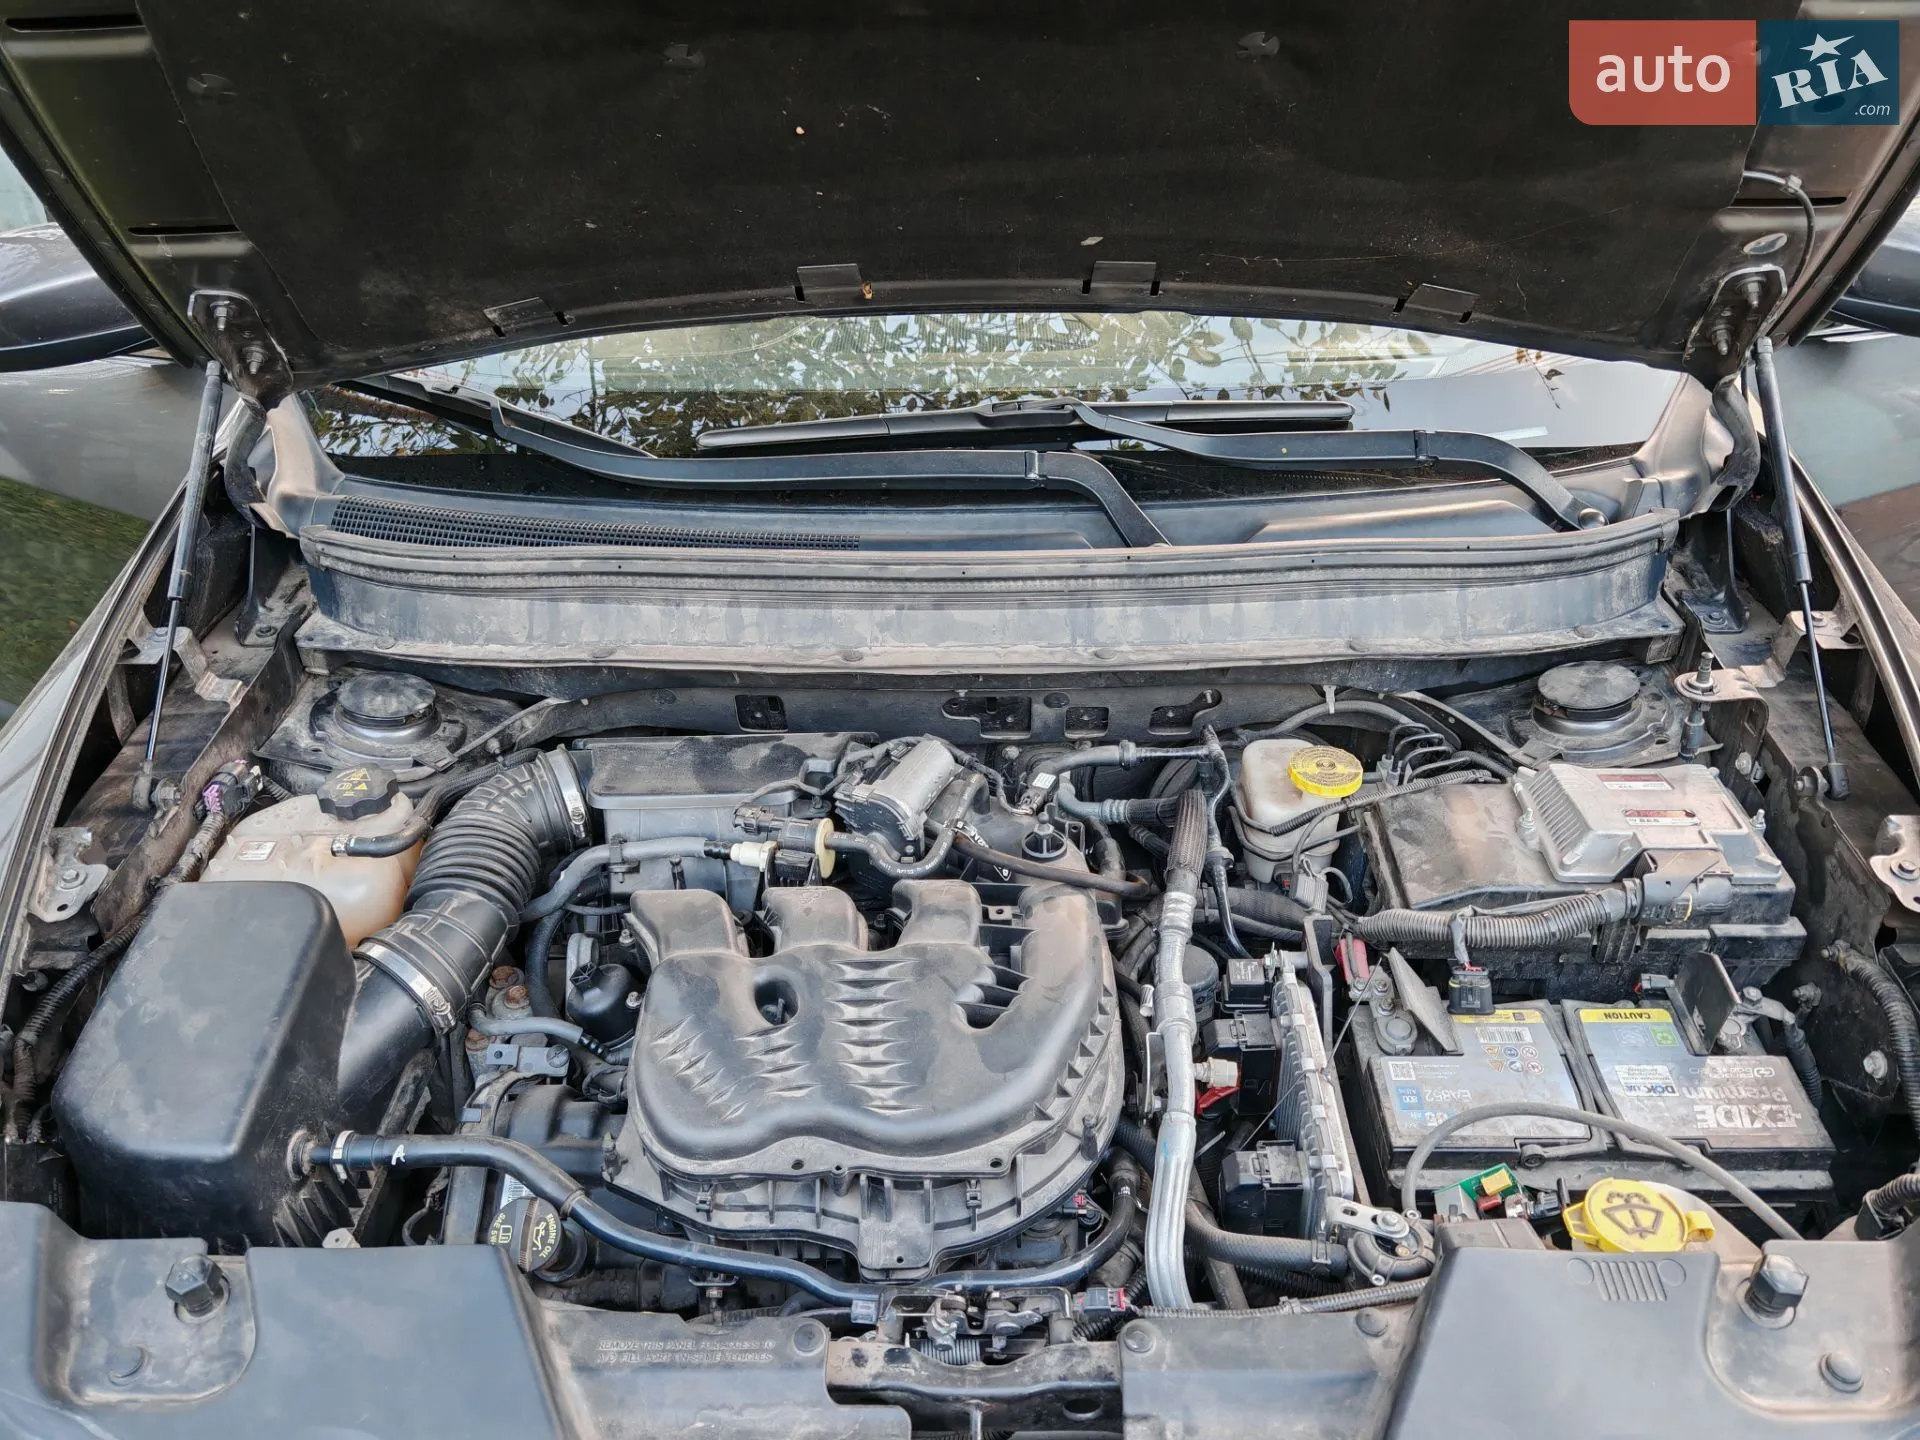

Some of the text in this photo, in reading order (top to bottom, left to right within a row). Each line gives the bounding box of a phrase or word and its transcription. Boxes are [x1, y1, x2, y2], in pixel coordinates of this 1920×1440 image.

[1603, 1012, 1651, 1021] CAUTION
[1682, 1084, 1788, 1104] Premium
[1693, 1104, 1797, 1128] EXIDE
[391, 1144, 406, 1166] A
[539, 1213, 557, 1258] ENGINE OIL
